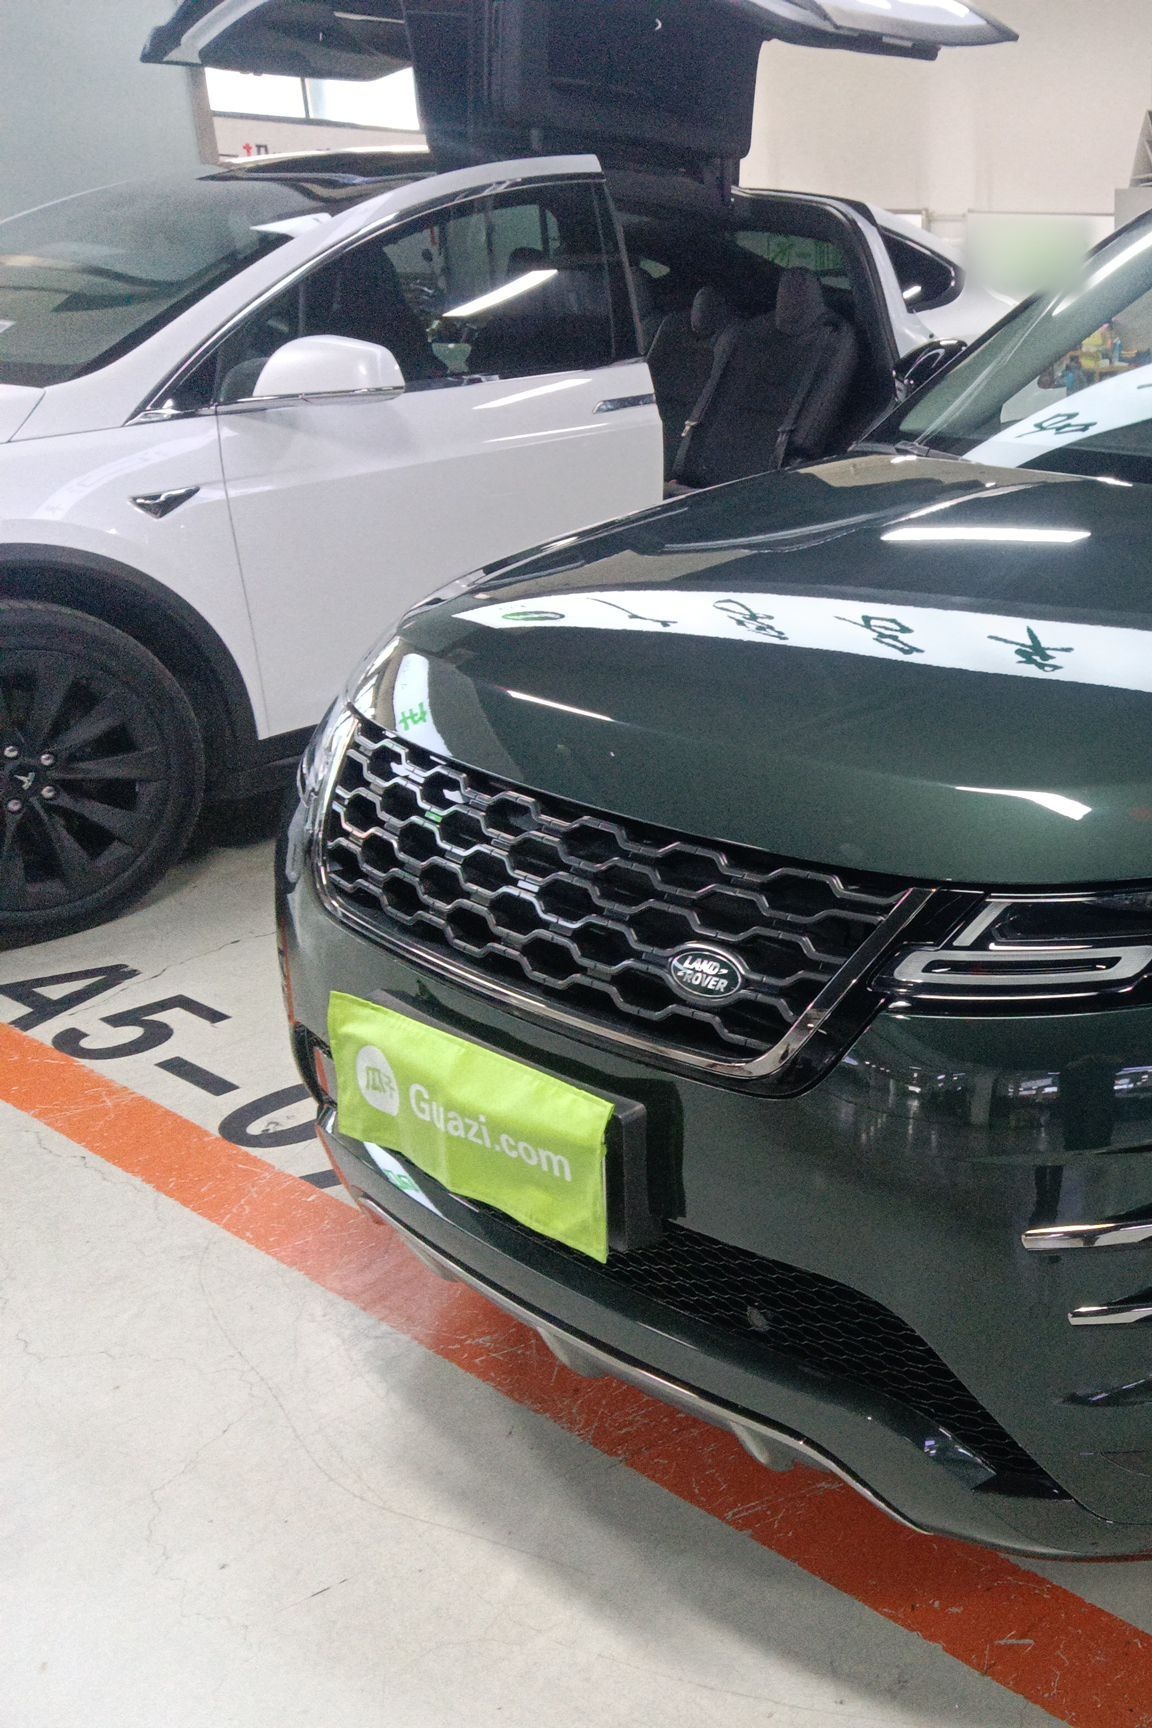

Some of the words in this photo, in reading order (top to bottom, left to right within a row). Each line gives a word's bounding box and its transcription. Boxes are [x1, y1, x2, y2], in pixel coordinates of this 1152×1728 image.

[682, 956, 720, 975] LAND
[682, 971, 728, 992] ROVER
[0, 963, 342, 1190] A5-0
[409, 1083, 572, 1183] Guazi.com
